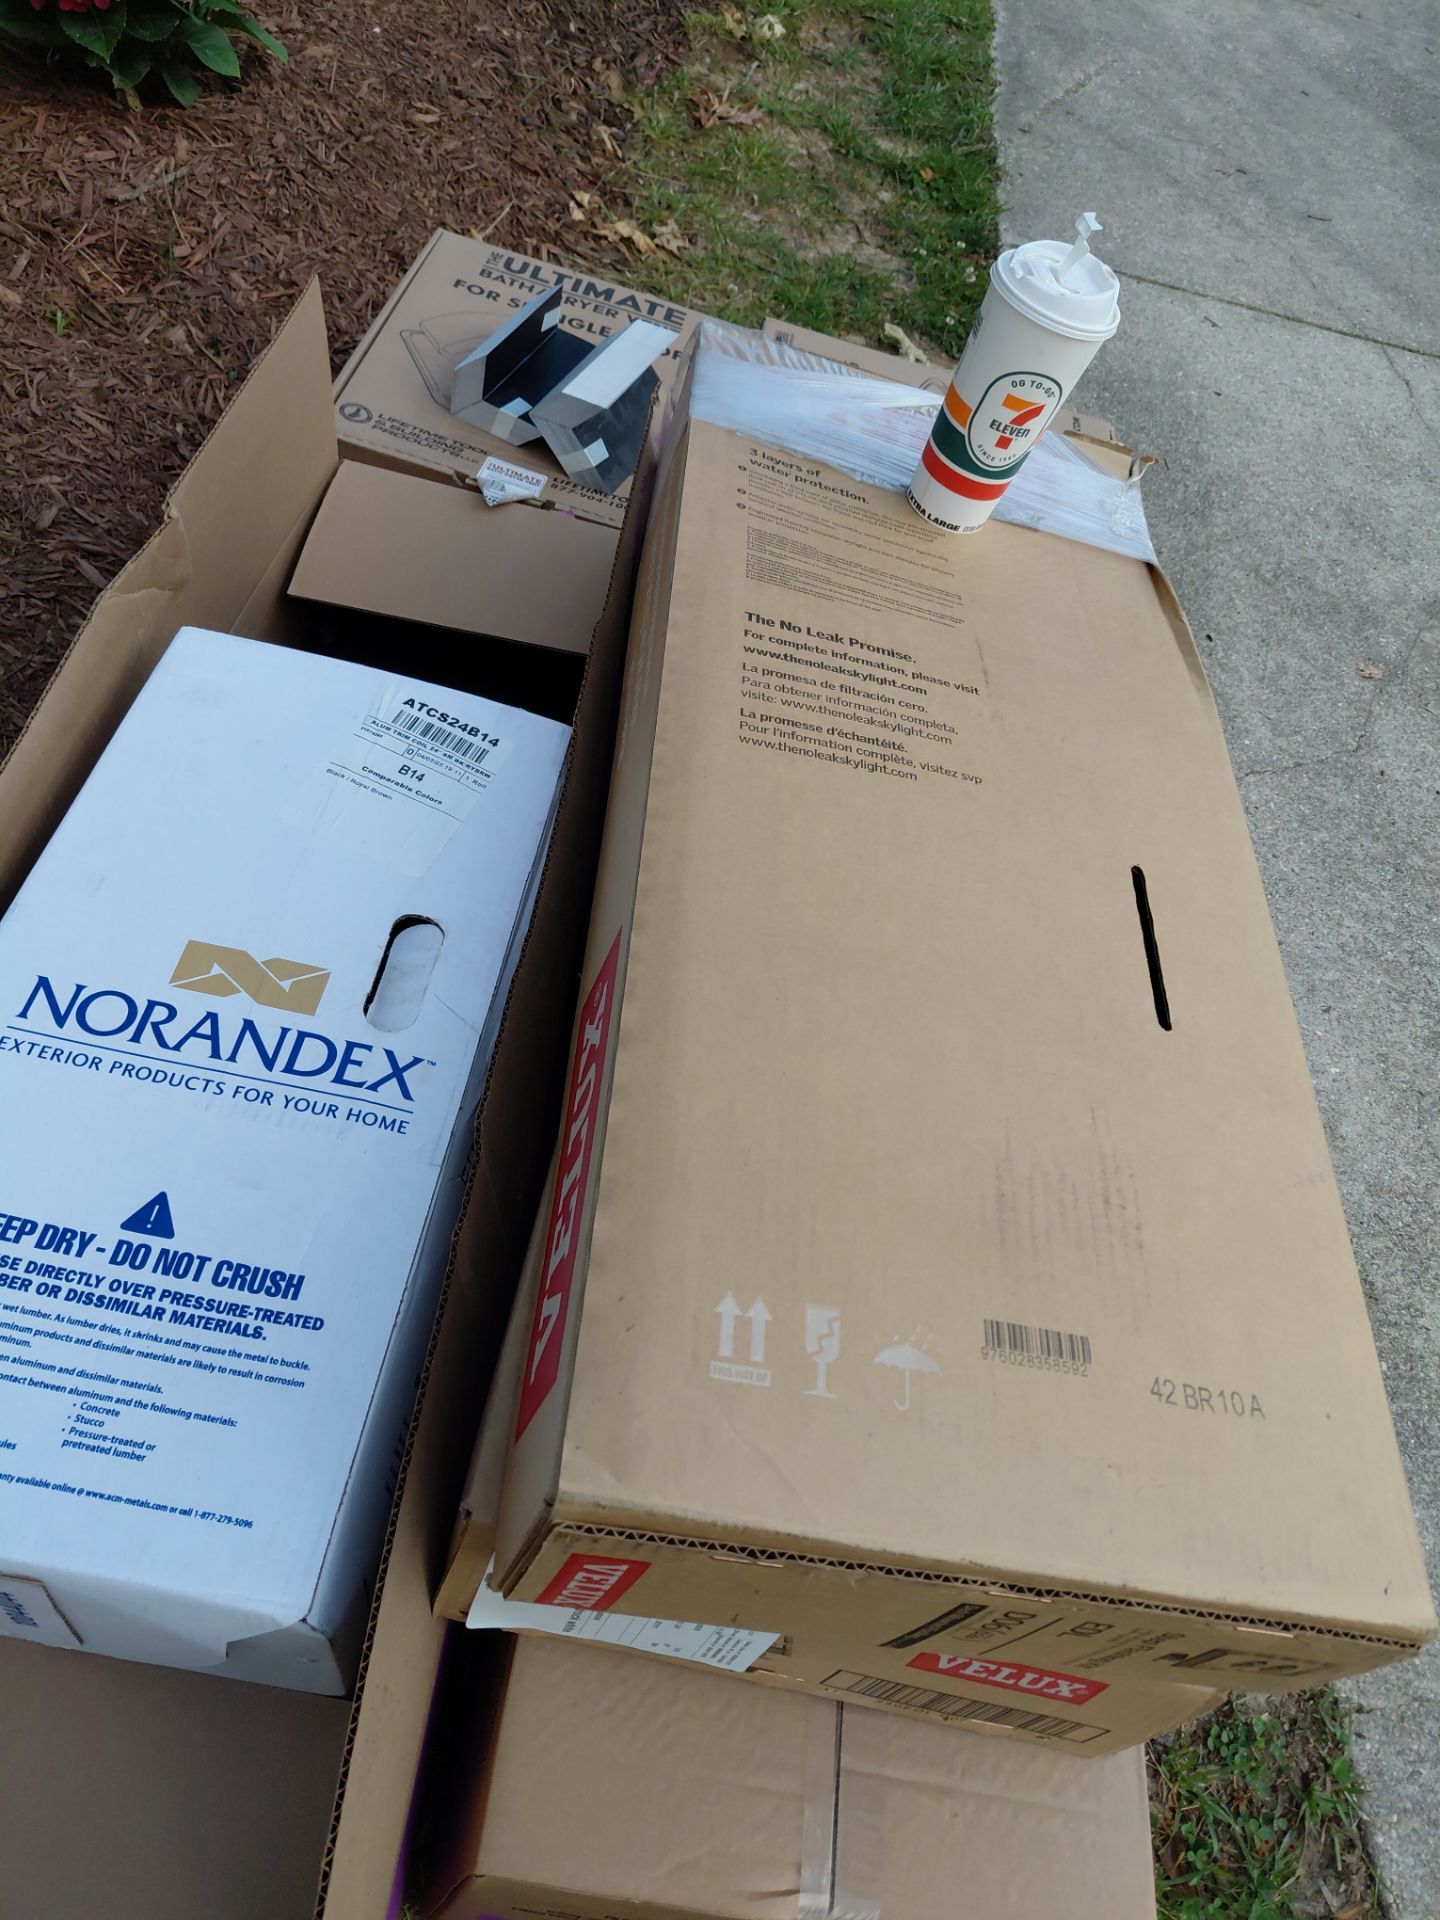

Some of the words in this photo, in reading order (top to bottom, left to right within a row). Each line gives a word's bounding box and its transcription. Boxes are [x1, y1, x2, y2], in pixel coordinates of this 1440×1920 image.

[453, 279, 501, 302] FOR
[503, 256, 688, 327] ULTIMATE
[1011, 379, 1026, 389] OG
[371, 424, 460, 459] PRODUCTS
[378, 413, 449, 441] LIFETIME
[389, 424, 465, 453] BUILDING
[994, 392, 1047, 451] 7
[749, 447, 758, 456] 3
[762, 452, 803, 472] layers
[806, 469, 822, 477] of
[976, 443, 996, 462] SINCE
[749, 458, 791, 478] water
[794, 475, 870, 505] protection.
[927, 512, 961, 532] LARGE
[745, 611, 776, 627] The
[779, 620, 802, 633] No
[806, 627, 845, 645] Leak
[848, 637, 917, 664] Promise.
[743, 629, 766, 640] For
[768, 636, 828, 656] complete
[831, 649, 909, 677] information,
[911, 671, 951, 688] please
[953, 682, 981, 696] visit
[743, 645, 928, 696] www.thenoleakskylight.com
[741, 675, 771, 690] Para
[774, 683, 823, 701] obtener
[825, 694, 897, 719] información
[900, 713, 960, 736] completa,
[742, 662, 758, 674] La
[761, 667, 818, 687] promesa
[820, 680, 837, 691] de
[838, 683, 895, 705] filtración
[898, 699, 929, 714] cero.
[370, 720, 392, 731] ALUM
[393, 729, 411, 742] TRIM
[411, 738, 428, 749] COIL
[402, 697, 501, 748] ATCS24B14
[740, 689, 777, 704] visite:
[780, 698, 953, 745] www.thenoleakskylight.com
[740, 707, 756, 719] La
[760, 712, 823, 733] promesse
[398, 764, 426, 783] B14
[406, 748, 415, 756] 0
[472, 779, 488, 790] Roll
[738, 735, 918, 782] www.thenoleakskylight.com
[739, 720, 769, 735] Pour
[773, 727, 853, 753] l'information
[856, 746, 917, 769] complète,
[919, 762, 959, 779] visitez
[961, 771, 983, 785] svp
[326, 768, 346, 779] Black
[350, 778, 371, 791] Royal
[370, 787, 394, 800] Brown
[361, 766, 414, 793] Comparable
[415, 790, 443, 805] Colors
[15, 975, 426, 1102] NORANDEX
[0, 1036, 103, 1071] EXTERIOR
[108, 1060, 226, 1096] PRODUCTS
[232, 1085, 274, 1106] FOR
[283, 1095, 340, 1119] YOUR
[345, 1108, 411, 1135] HOME
[529, 981, 608, 1385] VELUX
[34, 1223, 97, 1258] DRY
[108, 1239, 153, 1271] DO
[152, 1248, 212, 1282] NOT
[211, 1259, 306, 1301] CRUSH
[24, 1260, 106, 1289] DIRECTLY
[108, 1278, 157, 1300] OVER
[158, 1288, 325, 1331] PRESSURE-TREATED
[35, 1282, 62, 1299] OR
[64, 1288, 166, 1321] DISSIMILAR
[168, 1309, 267, 1341] MATERIALS.
[2, 1303, 21, 1314] wet
[20, 1306, 52, 1321] lumber.
[52, 1313, 65, 1323] As
[66, 1315, 98, 1331] lumber
[99, 1323, 122, 1337] dries,
[123, 1328, 132, 1337] it
[132, 1330, 163, 1343] shrinks
[164, 1336, 181, 1348] and
[182, 1341, 202, 1353] may
[202, 1345, 227, 1356] cause
[228, 1348, 242, 1359] the
[243, 1353, 268, 1364] metal
[269, 1356, 279, 1366] to
[280, 1357, 311, 1371] buckle.
[33, 1328, 73, 1344] products
[74, 1337, 91, 1348] and
[92, 1339, 135, 1356] dissimilar
[135, 1350, 177, 1366] materials
[177, 1358, 192, 1368] are
[193, 1359, 217, 1374] likely
[217, 1364, 228, 1374] to
[228, 1368, 254, 1381] result
[254, 1371, 264, 1381] in
[264, 1374, 305, 1389] corrosion
[11, 1355, 56, 1372] aluminum
[57, 1365, 76, 1377] and
[76, 1368, 120, 1385] dissimilar
[120, 1379, 164, 1395] materials.
[1150, 1377, 1179, 1406] 42
[27, 1376, 66, 1393] between
[68, 1386, 113, 1403] aluminum
[115, 1395, 133, 1407] and
[133, 1399, 149, 1411] the
[150, 1402, 192, 1421] following
[193, 1412, 238, 1428] materials:
[74, 1414, 105, 1428] Stucco
[80, 1402, 120, 1418] Concrete
[61, 1438, 112, 1456] pretreated
[112, 1447, 147, 1462] lumber
[68, 1426, 145, 1450] Pressure-treated
[145, 1443, 157, 1452] or
[15, 1475, 51, 1489] available
[51, 1482, 76, 1494] online
[76, 1488, 85, 1496] @
[85, 1489, 169, 1513] www.acm-metals.com
[168, 1506, 178, 1514] or
[178, 1507, 194, 1518] call
[194, 1509, 254, 1528] 1-877-279-5096
[552, 1563, 631, 1609] VELUX
[937, 1654, 1088, 1698] VELUX
